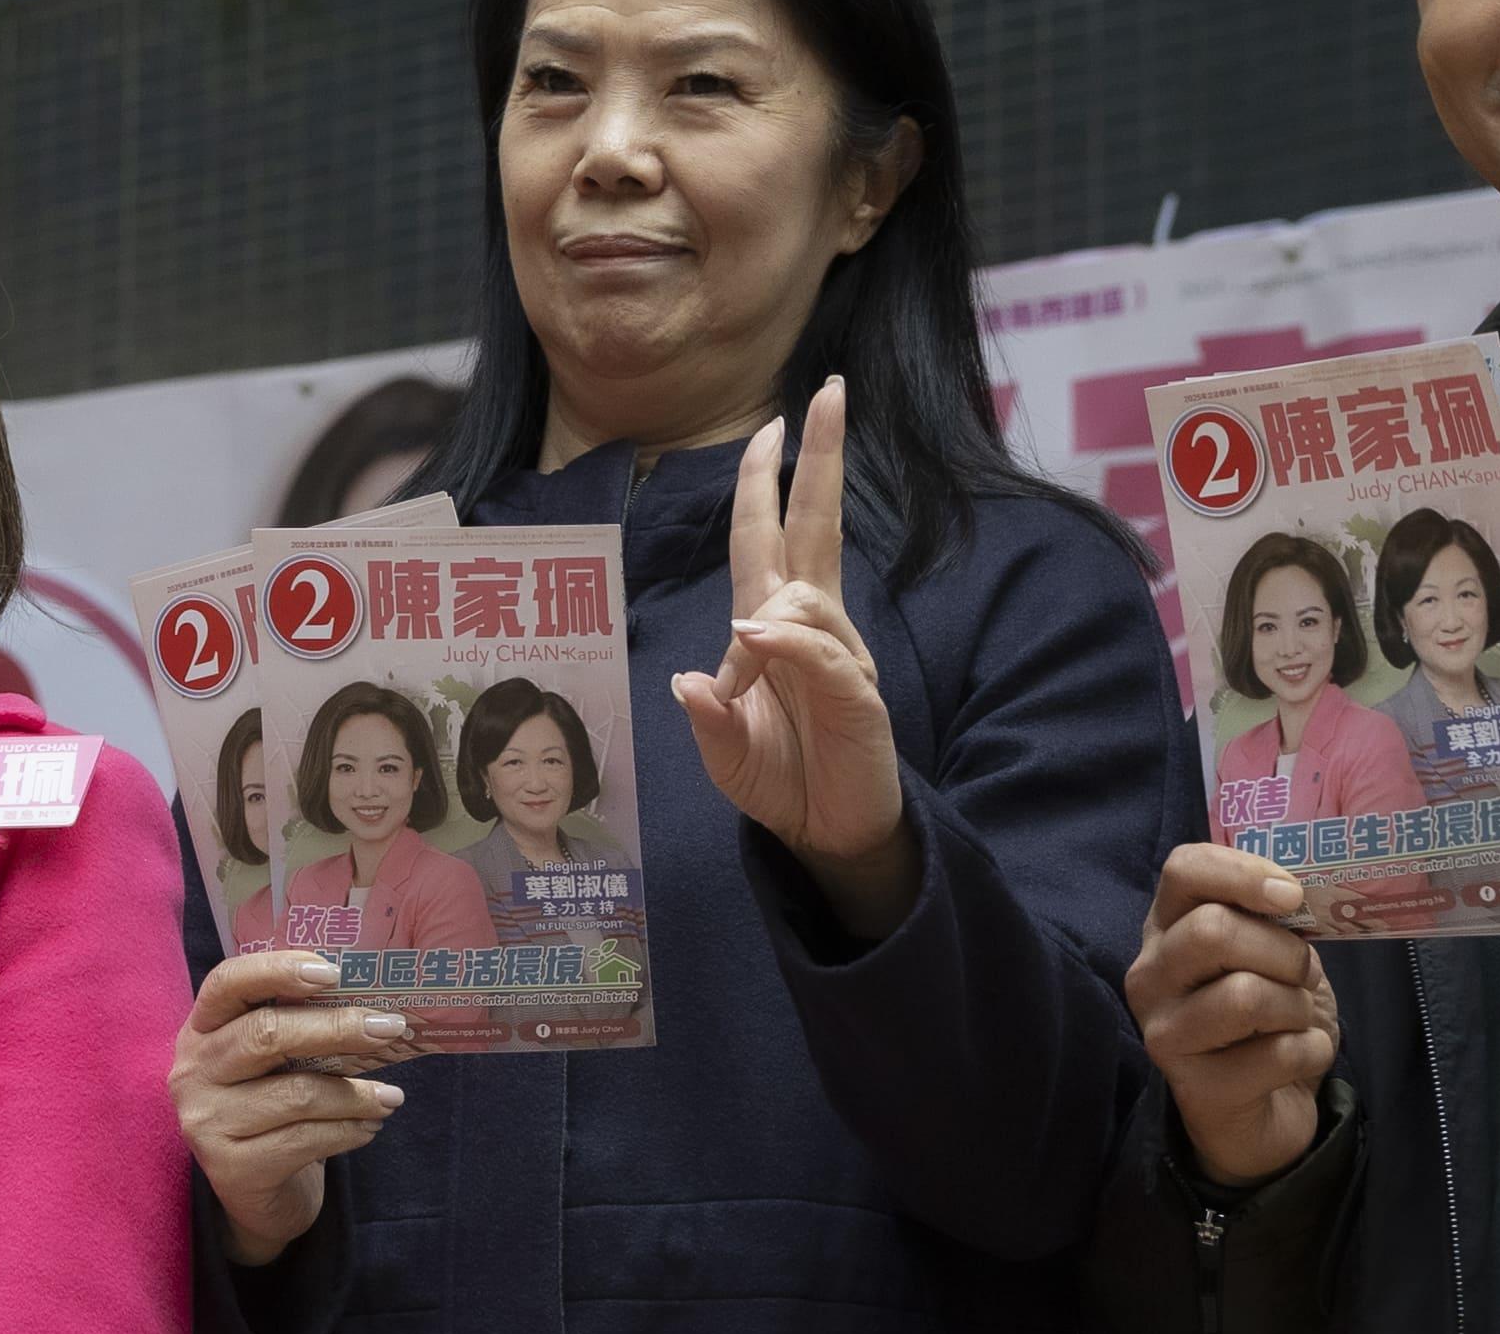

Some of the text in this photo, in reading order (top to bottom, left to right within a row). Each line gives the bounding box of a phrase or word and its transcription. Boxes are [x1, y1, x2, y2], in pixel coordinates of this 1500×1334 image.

[1191, 421, 1240, 499] 2
[1346, 478, 1392, 503] Judy
[291, 569, 336, 641] 2
[366, 555, 614, 641] 陳家珮
[174, 608, 220, 683] 2
[442, 645, 490, 669] Judy
[37, 742, 79, 753] CHAN
[1462, 776, 1473, 785] IN
[1475, 772, 1500, 783] FULL
[1219, 775, 1290, 827] 改善
[544, 859, 607, 875] Regina IP
[1299, 874, 1330, 889] uality
[1331, 871, 1345, 885] of
[1346, 868, 1371, 881] Life
[1373, 867, 1384, 878] in
[1387, 864, 1408, 876] the
[1409, 859, 1453, 874] Central
[1454, 854, 1479, 868] and
[524, 873, 629, 900] 葉劉淑儀
[542, 900, 616, 916] 全力支持
[286, 905, 363, 948] 改善
[535, 920, 624, 931] IN FULL SUPPORT
[353, 996, 393, 1010] Quality
[396, 996, 409, 1008] of
[412, 995, 435, 1007] Life
[437, 996, 448, 1007] in
[450, 995, 470, 1006] the
[473, 993, 516, 1006] Central
[518, 992, 541, 1005] and
[541, 992, 591, 1005] Western
[592, 990, 638, 1004] District
[580, 1026, 600, 1036] Judy
[602, 1024, 625, 1034] Chan
